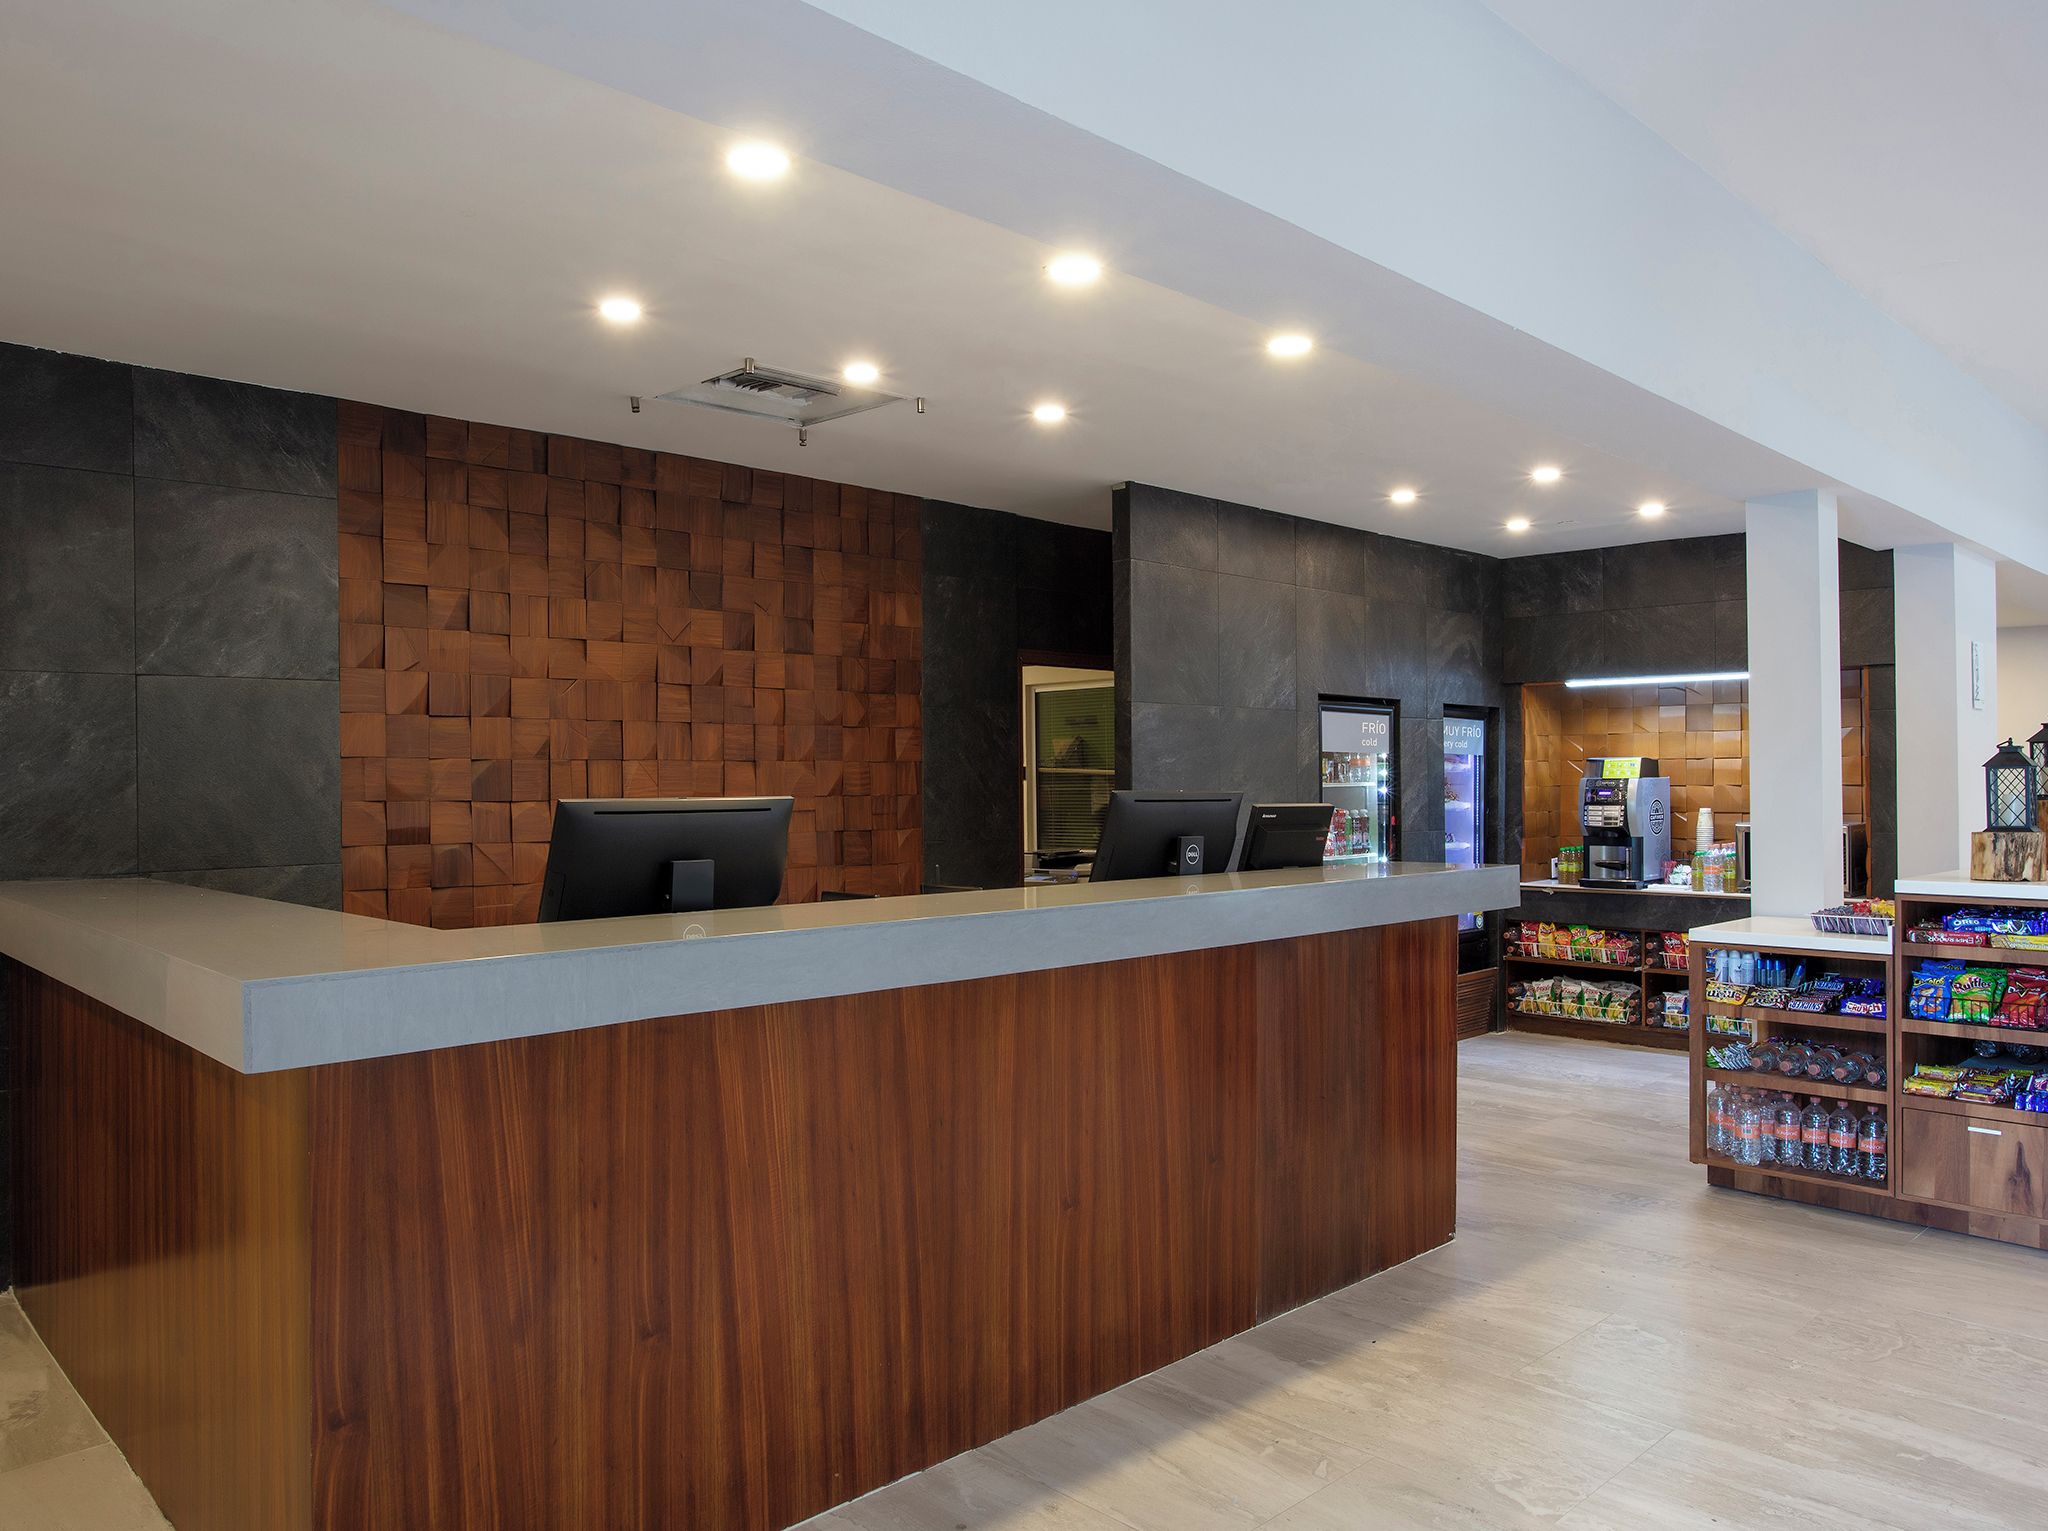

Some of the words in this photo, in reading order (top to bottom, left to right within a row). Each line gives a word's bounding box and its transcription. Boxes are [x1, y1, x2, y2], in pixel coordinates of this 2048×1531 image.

[1362, 721, 1386, 735] FRÍO
[1462, 725, 1481, 738] FRÍO
[1362, 738, 1378, 747] cold
[1444, 741, 1454, 750] ery
[1455, 740, 1468, 749] cold
[1952, 975, 1993, 994] Ruffles
[1846, 1002, 1883, 1014] CRUNCH
